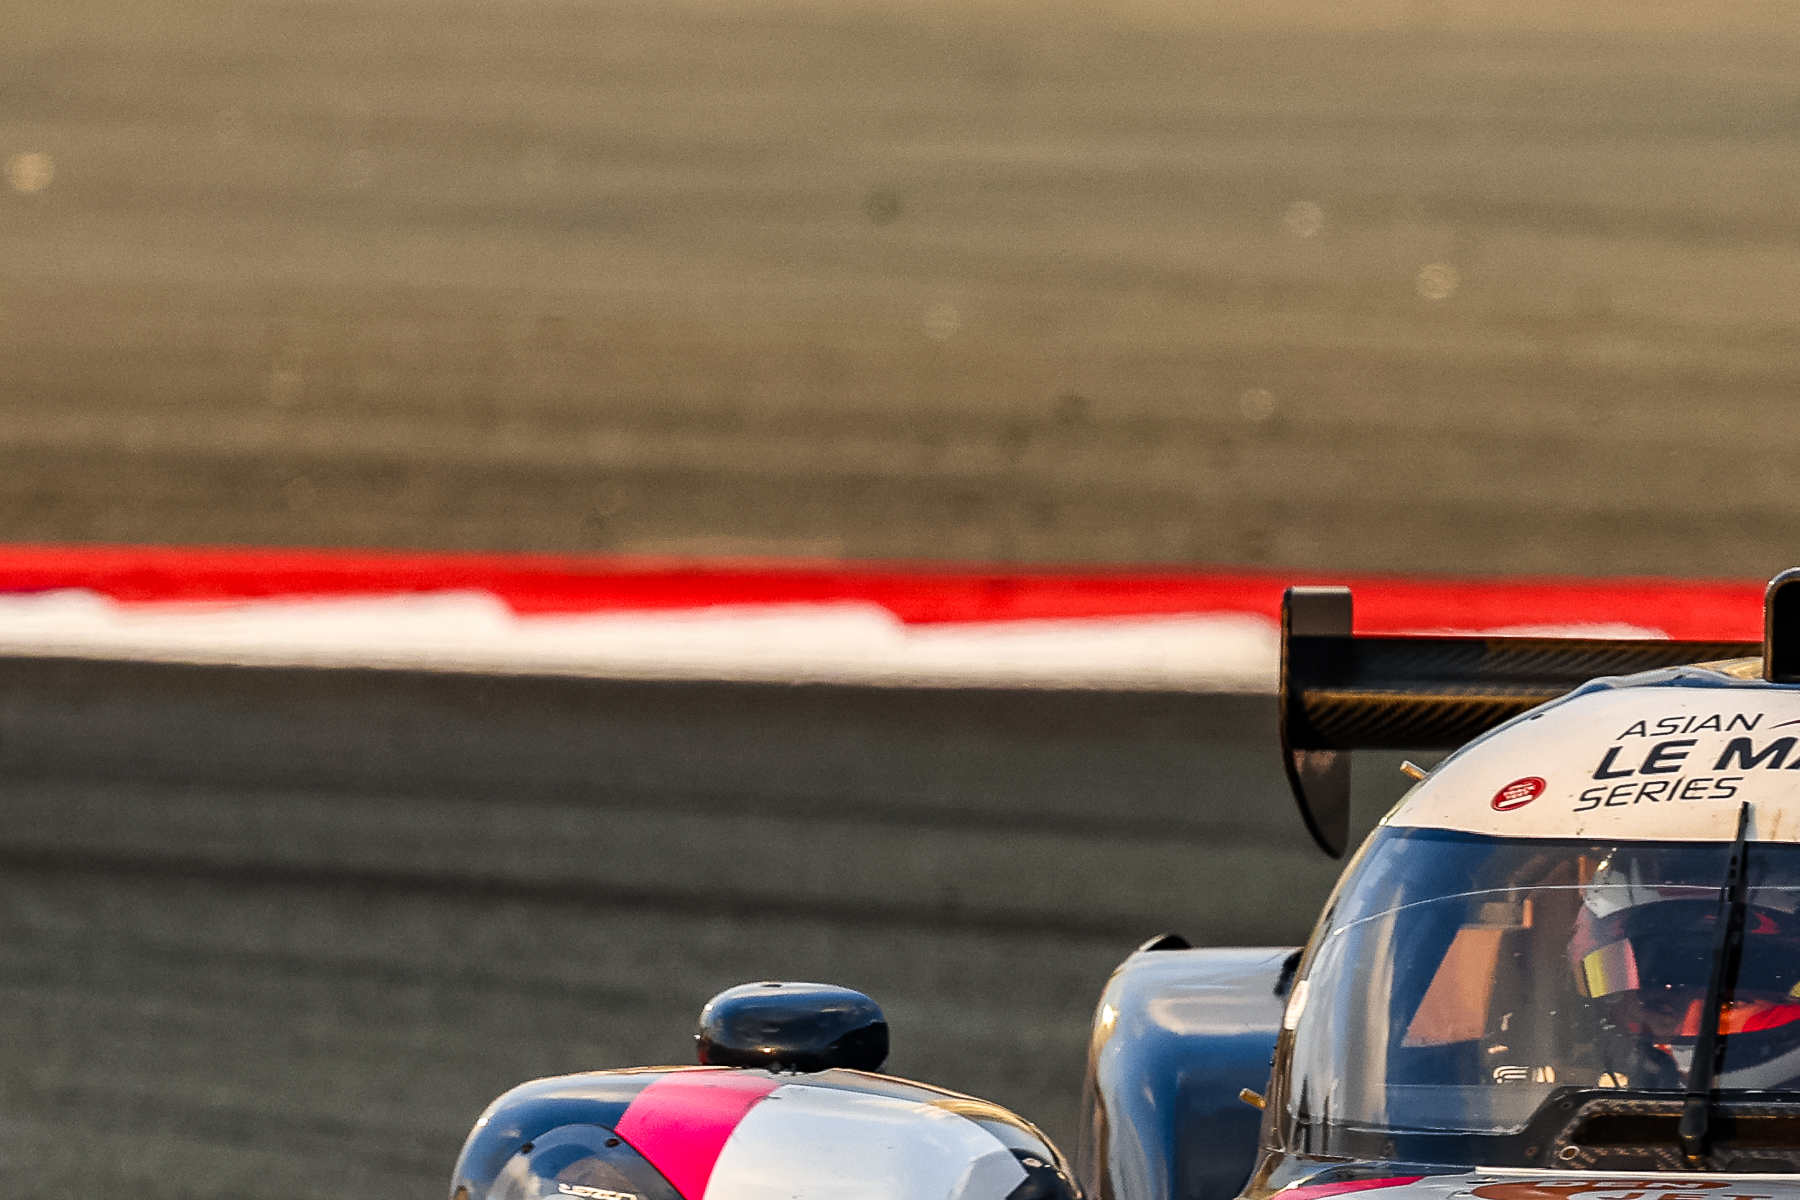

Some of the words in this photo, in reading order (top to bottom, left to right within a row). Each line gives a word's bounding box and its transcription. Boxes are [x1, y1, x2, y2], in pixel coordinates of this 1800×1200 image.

[1616, 713, 1764, 740] ASIAN
[1592, 738, 1698, 780] LE
[1573, 777, 1744, 812] SERIES
[1535, 1180, 1704, 1189] DEN
